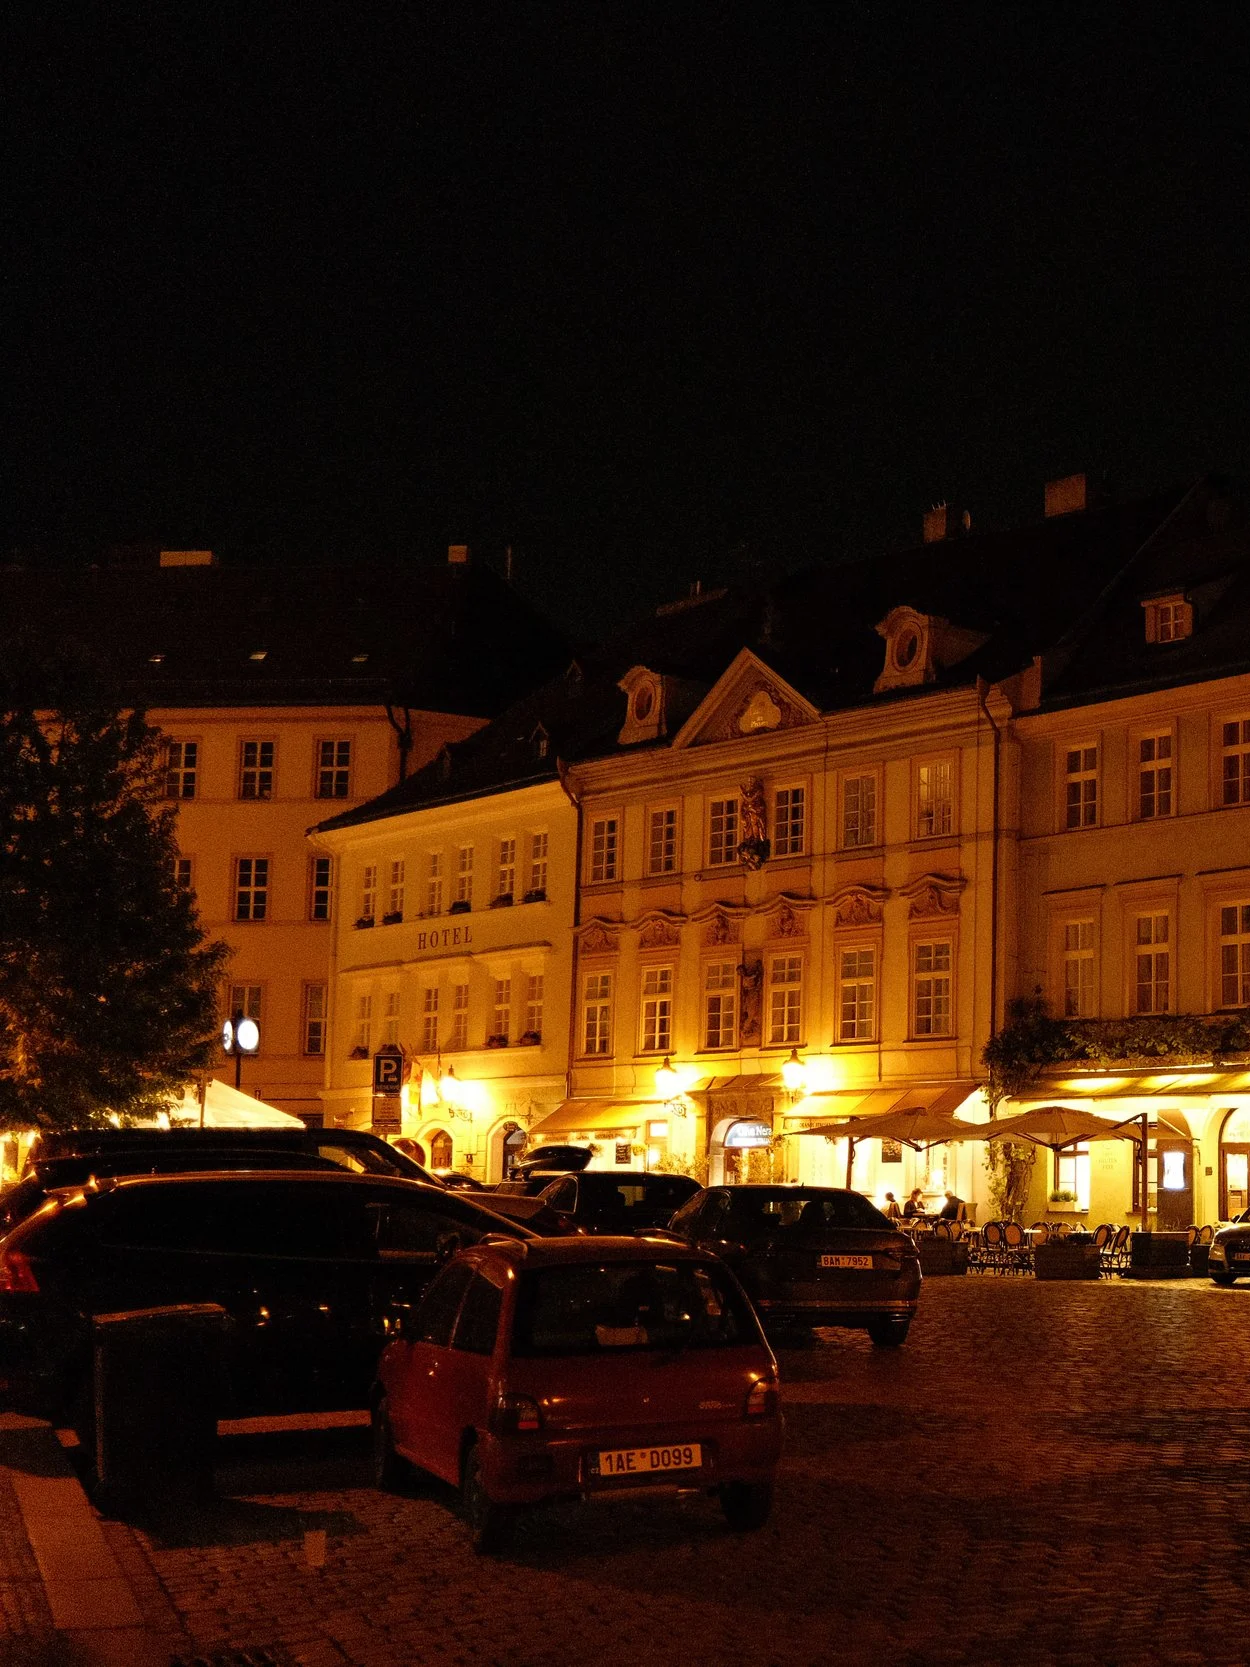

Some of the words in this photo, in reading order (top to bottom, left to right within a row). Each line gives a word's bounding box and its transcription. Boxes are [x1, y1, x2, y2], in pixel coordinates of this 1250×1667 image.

[417, 925, 473, 950] HOTEL
[379, 1059, 398, 1083] P
[847, 1256, 869, 1266] 7952
[604, 1452, 637, 1472] 1AE
